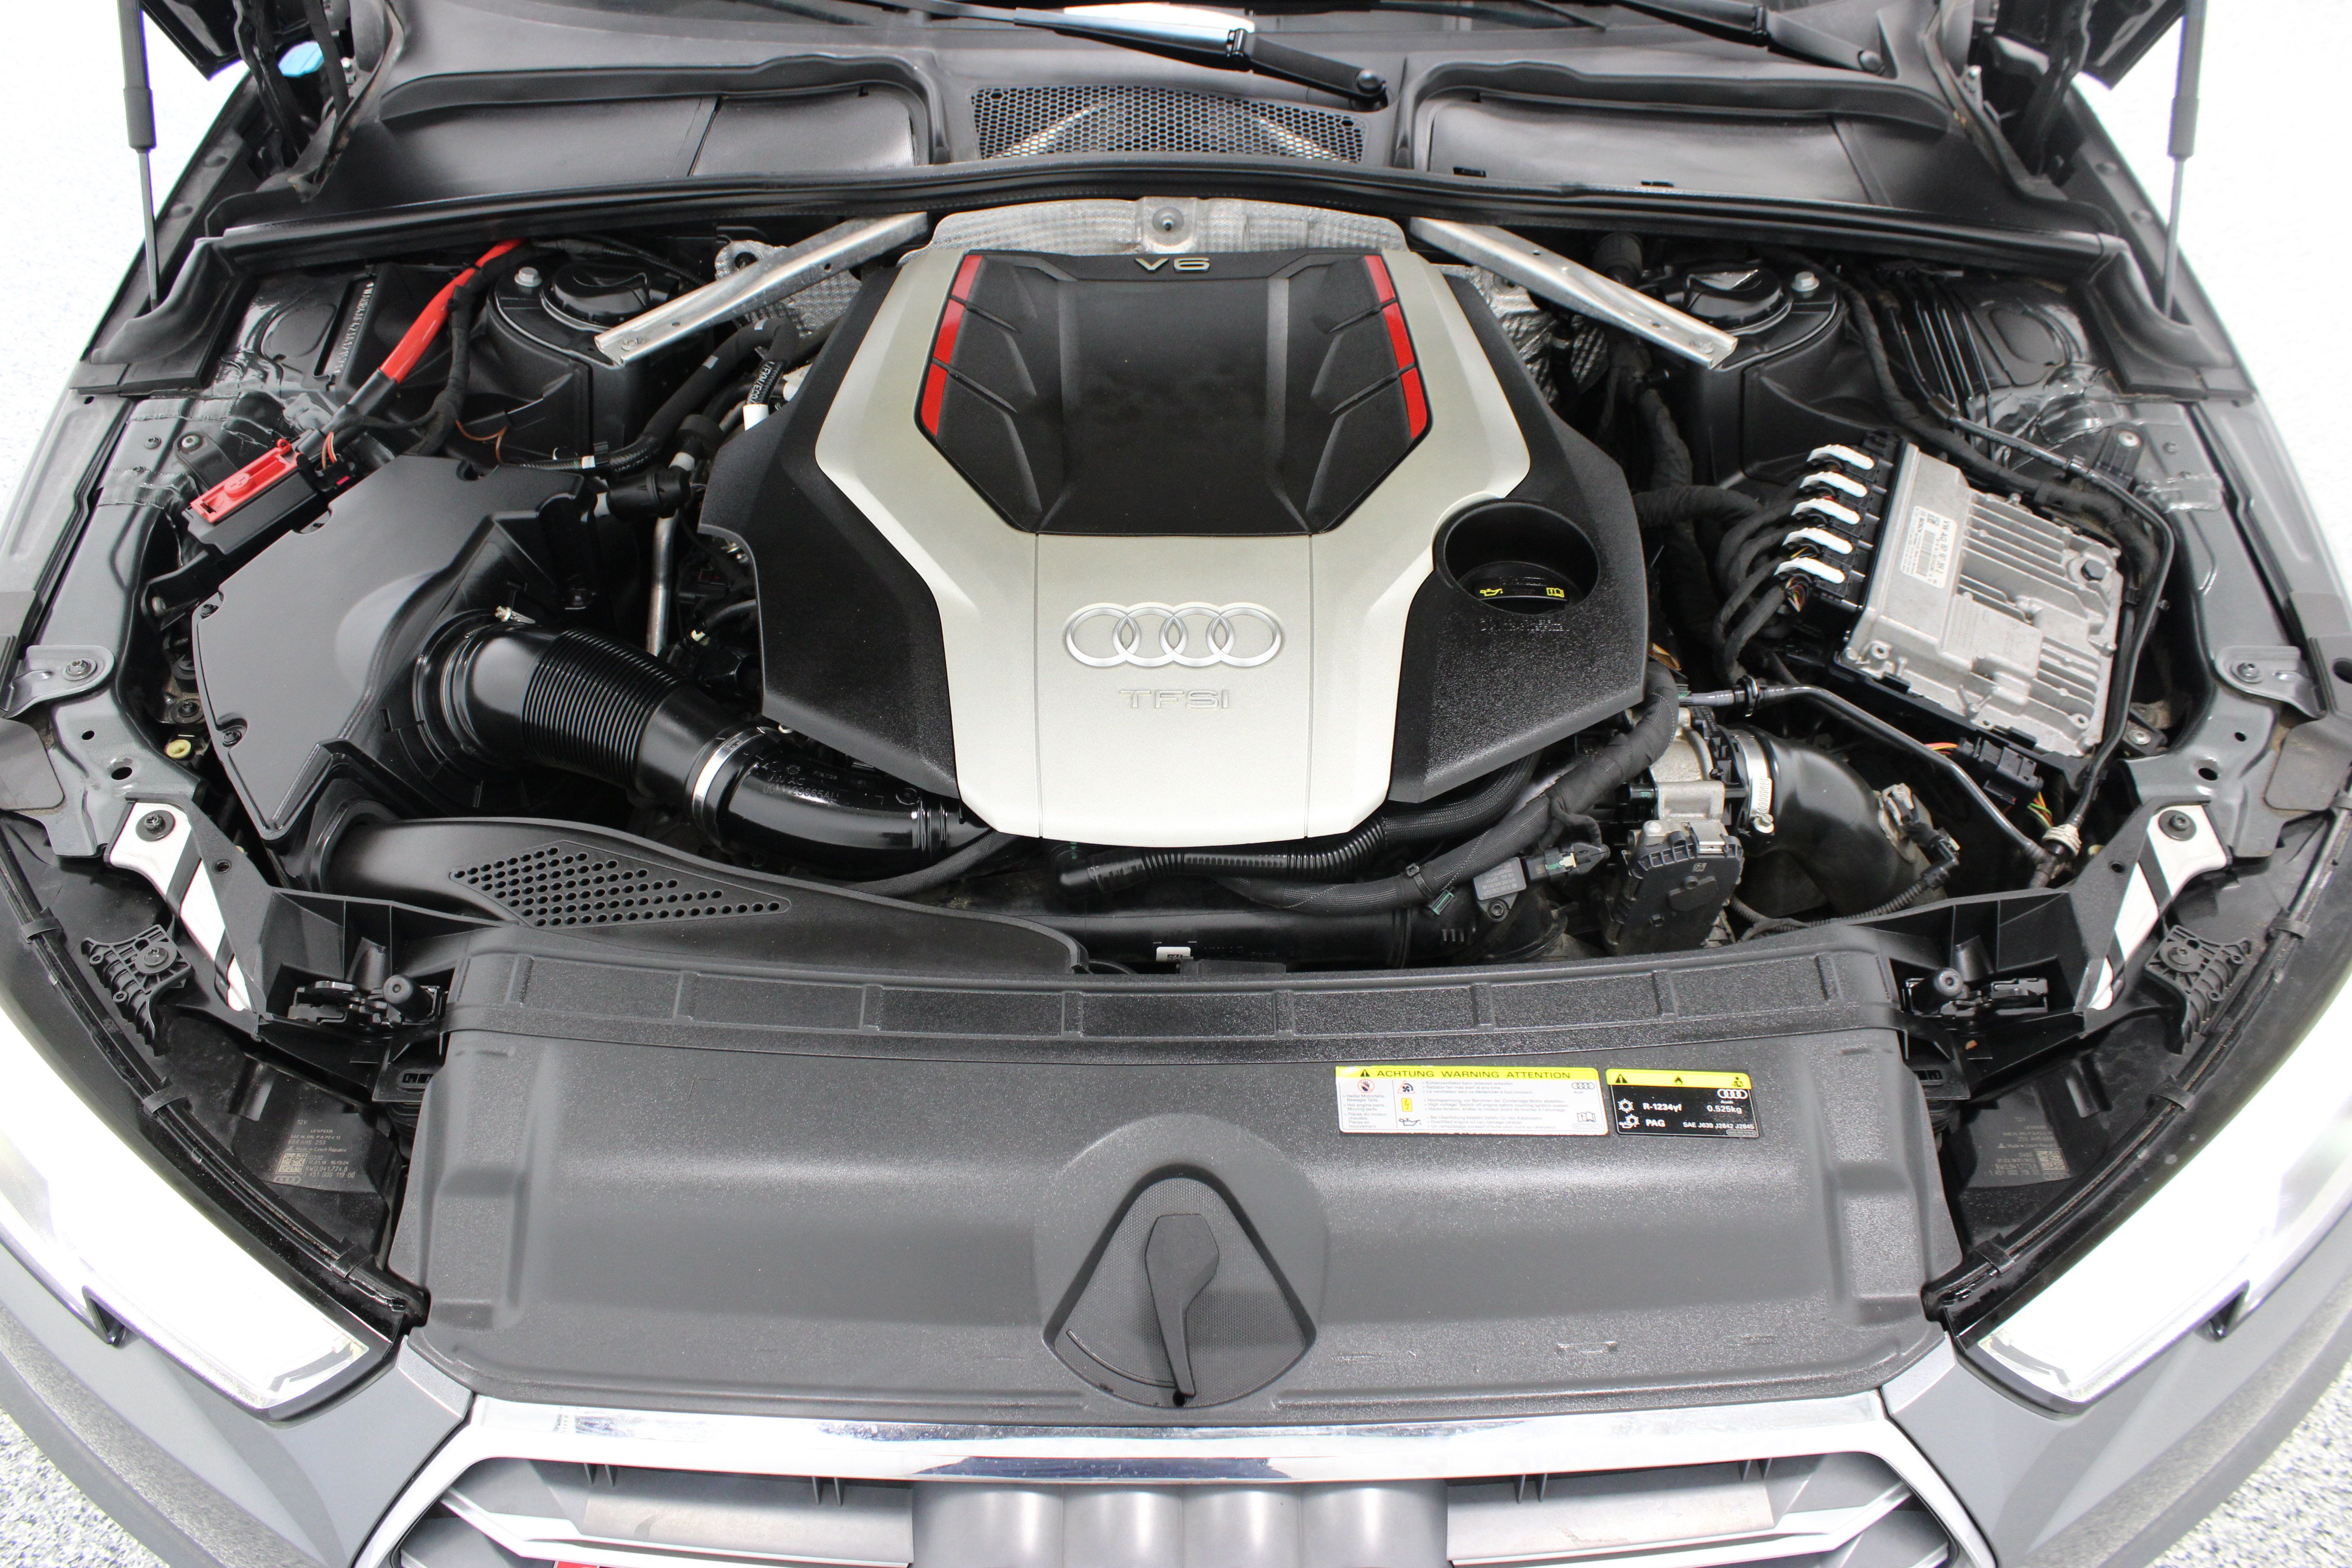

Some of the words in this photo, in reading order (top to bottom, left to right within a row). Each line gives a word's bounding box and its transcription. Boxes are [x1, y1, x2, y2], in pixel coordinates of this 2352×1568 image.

[1134, 257, 1210, 272] V6
[1120, 690, 1229, 709] TFSI
[1643, 1103, 1682, 1112] R-1234yf
[1707, 1105, 1743, 1114] 0.525kg
